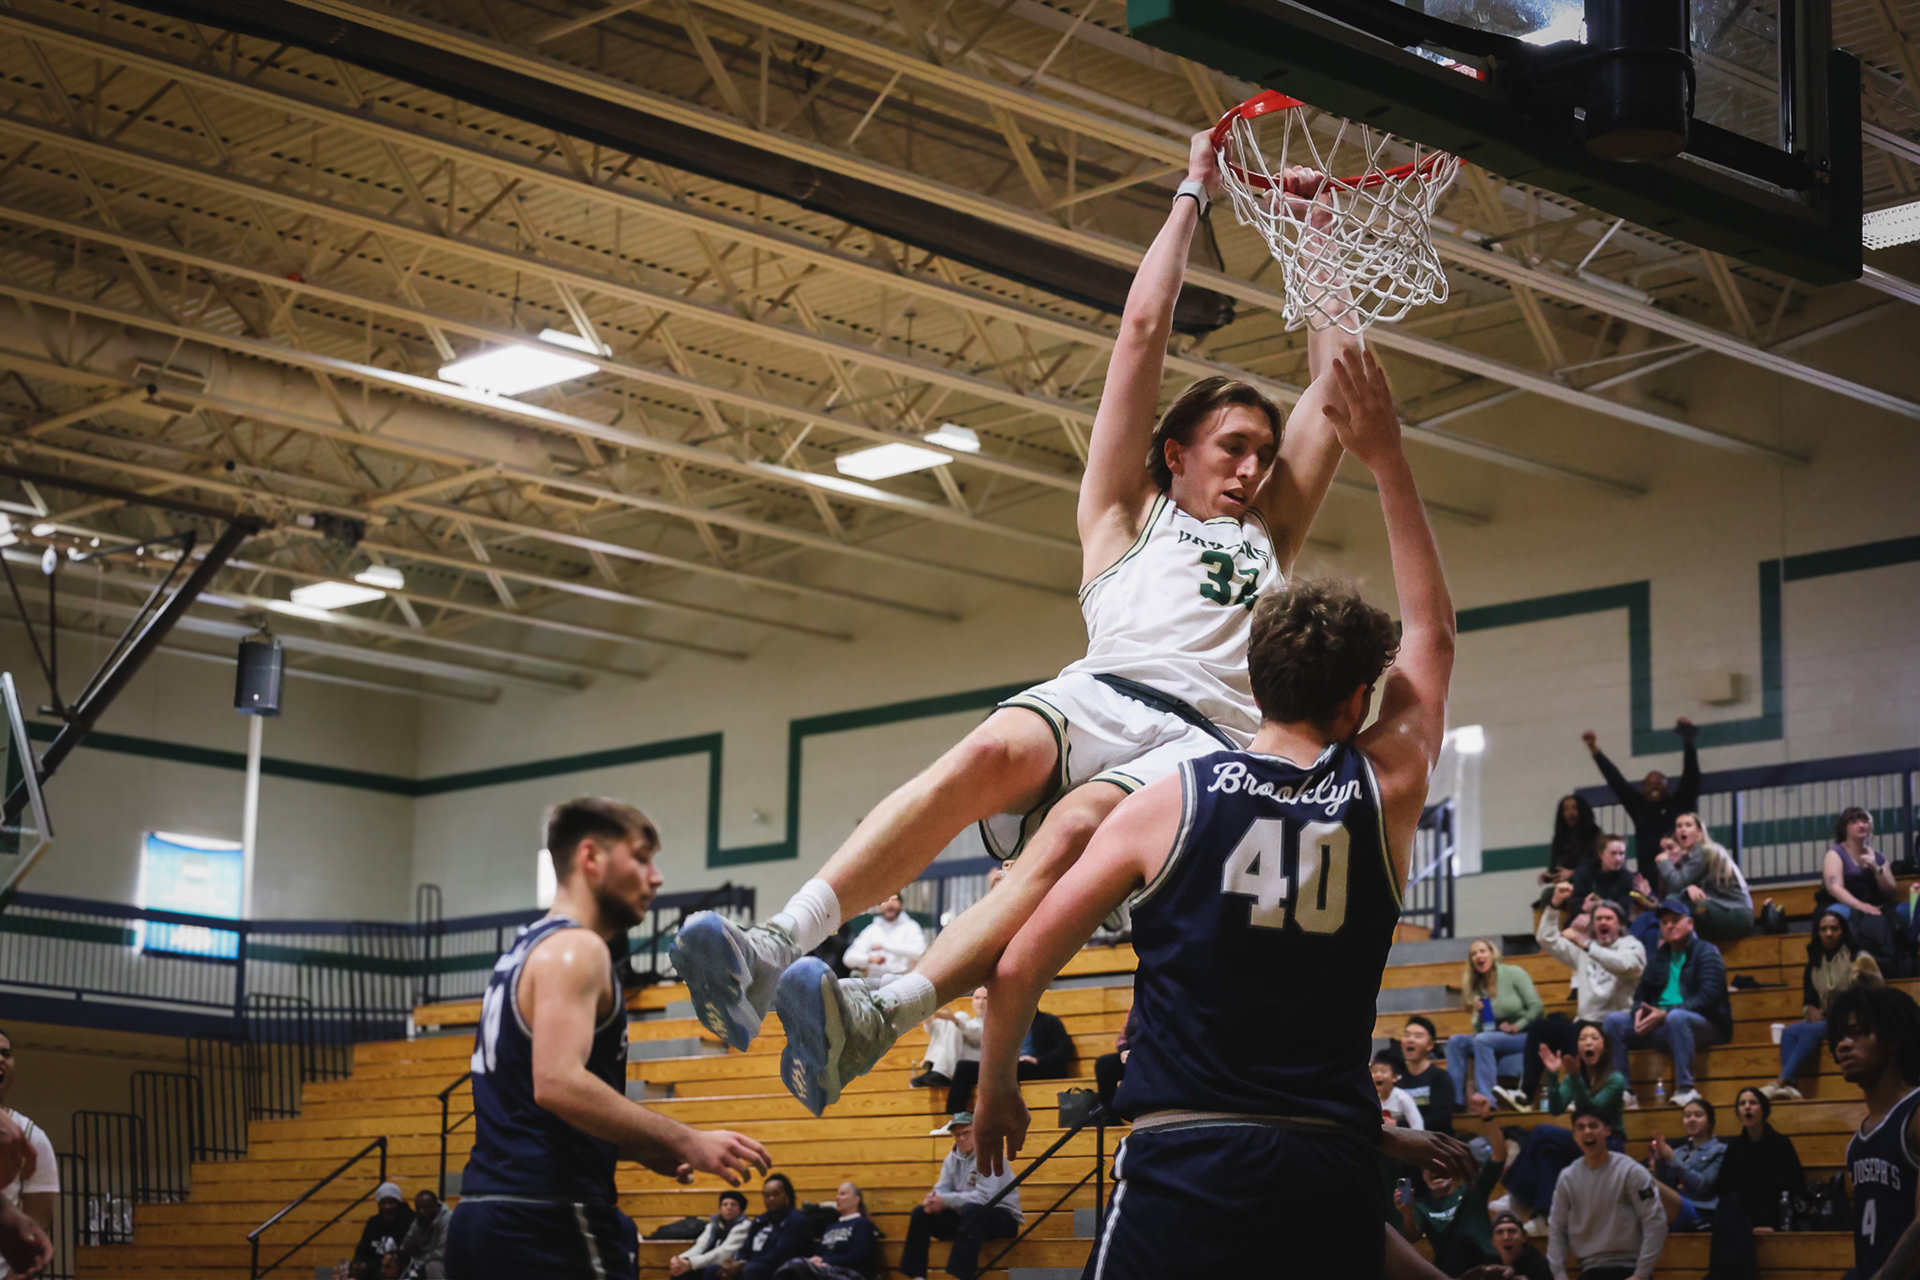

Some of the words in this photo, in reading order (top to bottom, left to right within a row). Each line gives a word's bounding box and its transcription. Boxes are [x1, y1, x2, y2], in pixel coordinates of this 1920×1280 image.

[1207, 761, 1363, 816] Brooklyn
[1220, 817, 1351, 935] 40
[1861, 1198, 1877, 1246] 4
